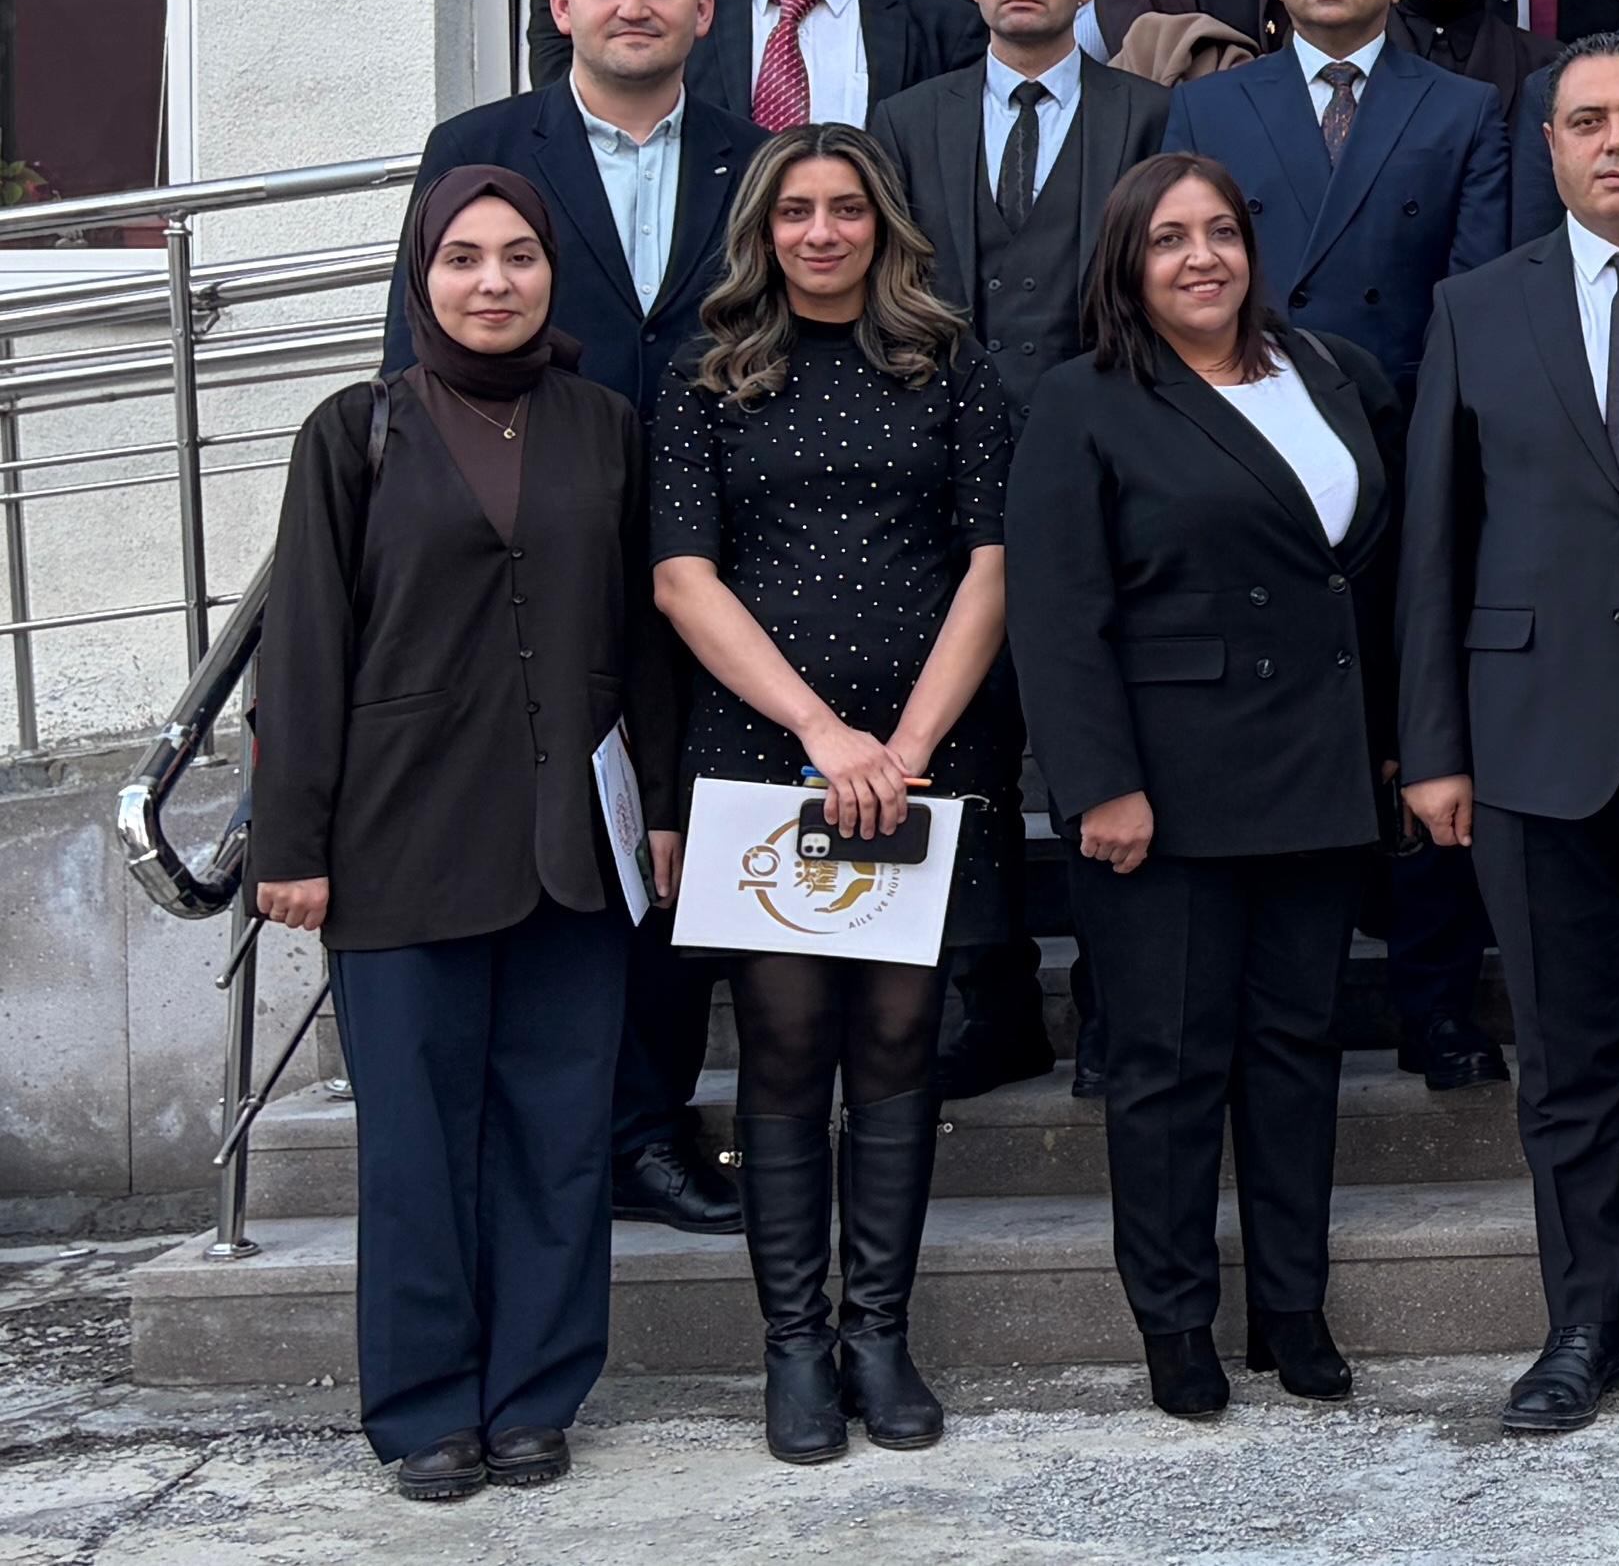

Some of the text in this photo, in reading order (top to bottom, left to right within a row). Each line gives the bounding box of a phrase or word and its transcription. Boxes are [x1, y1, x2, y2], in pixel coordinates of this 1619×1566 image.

[848, 863, 901, 929] AİLE VE NÜFU
